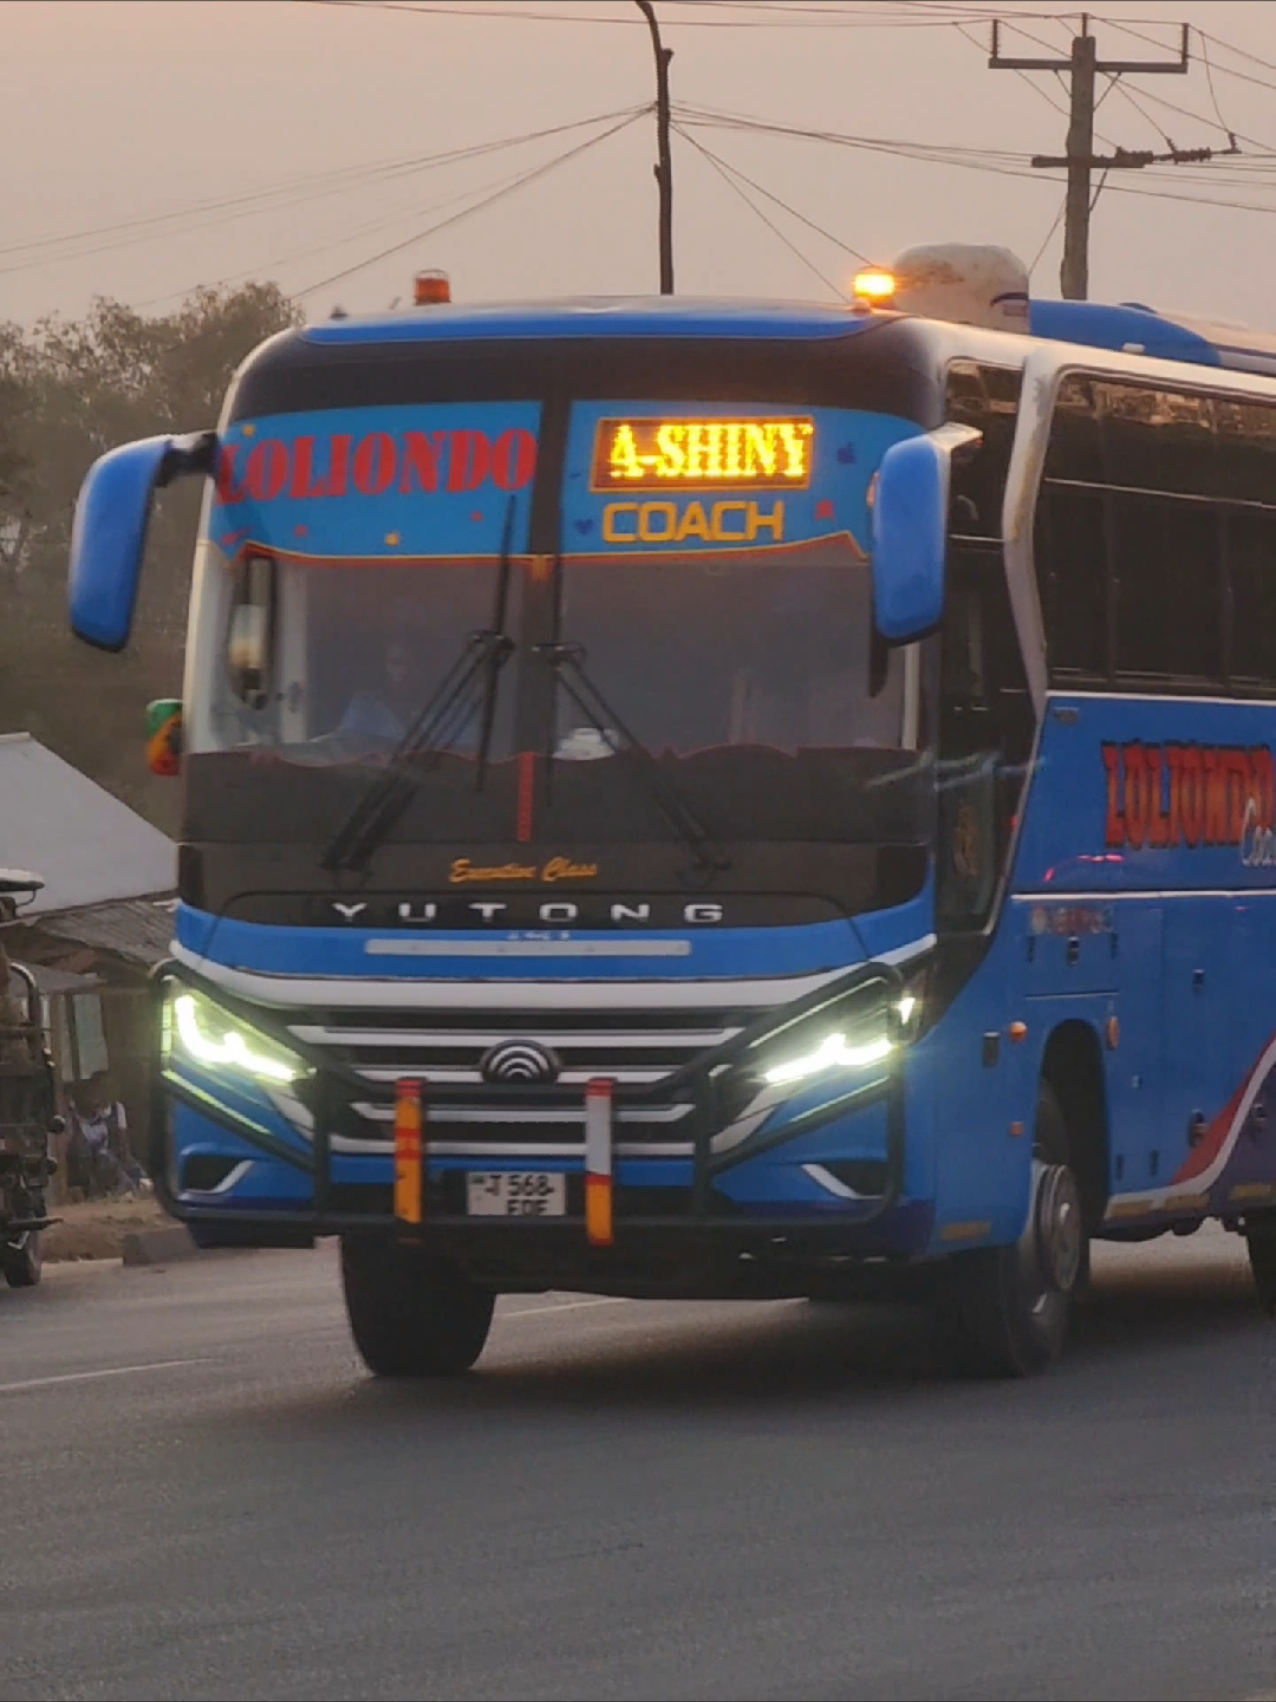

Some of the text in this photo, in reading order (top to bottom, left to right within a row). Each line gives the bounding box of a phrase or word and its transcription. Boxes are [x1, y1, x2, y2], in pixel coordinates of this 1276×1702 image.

[215, 428, 537, 505] LOLIONDO
[609, 423, 814, 477] A-SHINY
[603, 500, 785, 543] COACH
[332, 902, 724, 923] YUTONG
